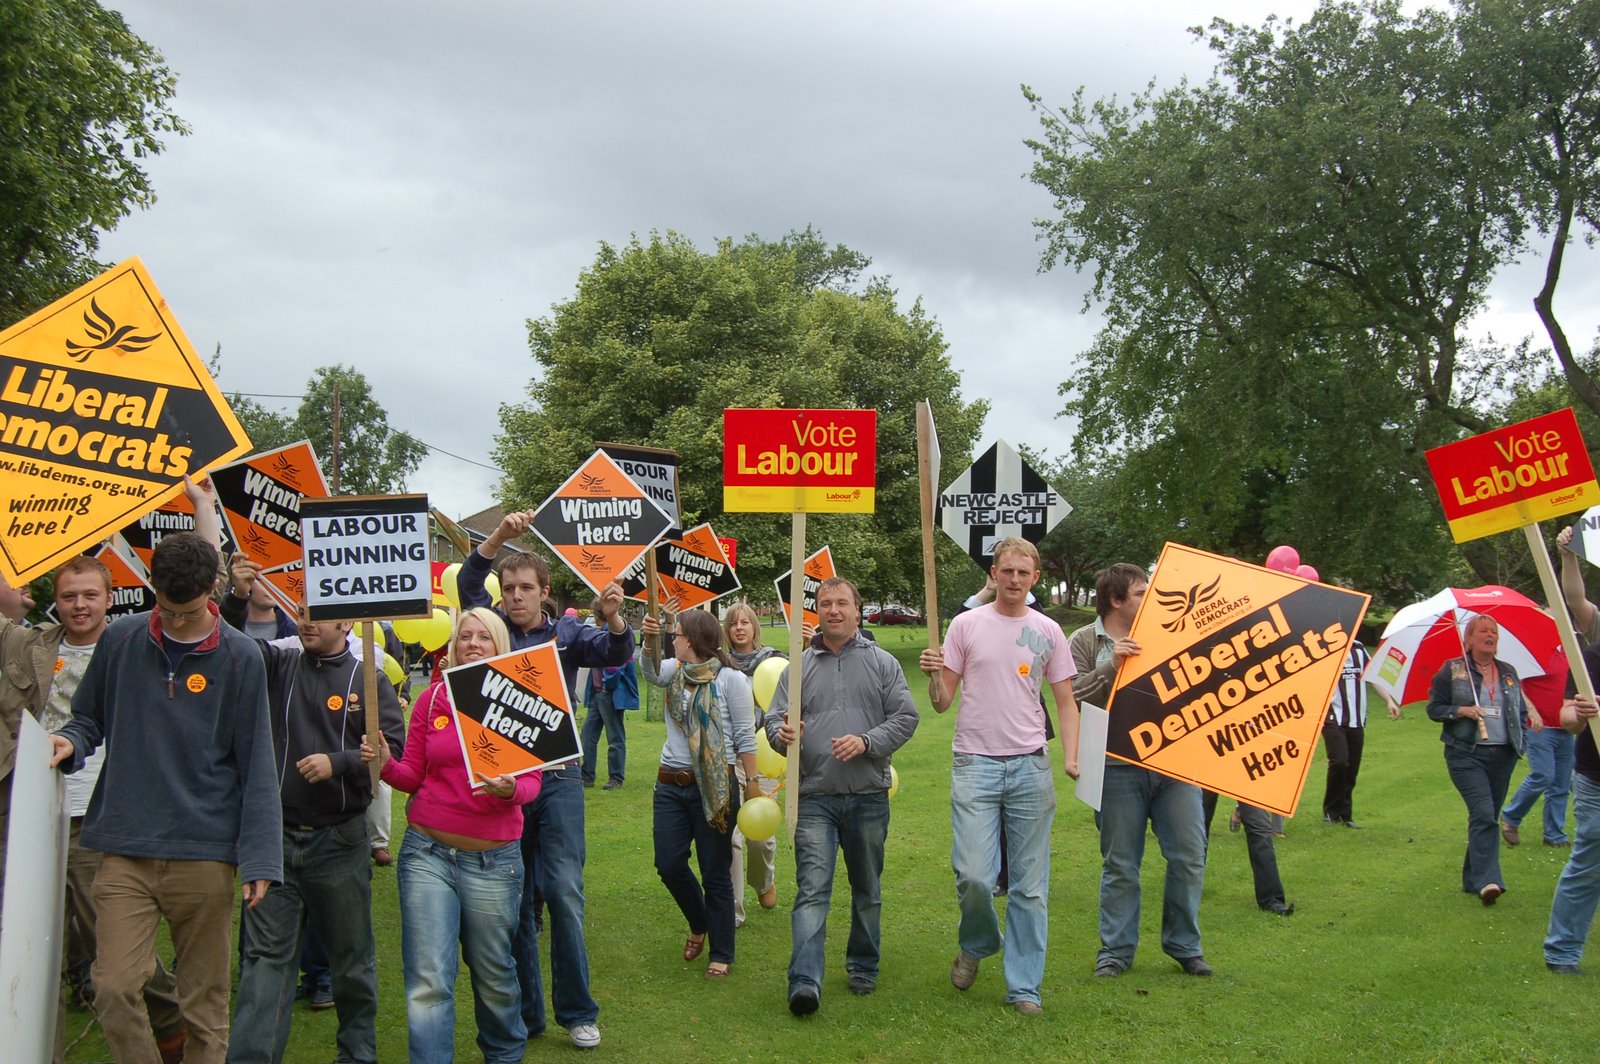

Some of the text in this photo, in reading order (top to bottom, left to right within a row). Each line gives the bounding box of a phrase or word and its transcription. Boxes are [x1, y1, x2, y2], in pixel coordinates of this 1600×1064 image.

[1, 364, 169, 429] Liberal
[0, 411, 193, 478] mocrats
[792, 420, 857, 447] Vote
[1494, 430, 1562, 463] Vote
[614, 460, 668, 481] BOUR
[738, 444, 858, 475] Labour
[0, 460, 148, 499] w.libdems.org.uk
[244, 468, 304, 514] Winni
[1451, 452, 1569, 506] Labour
[9, 492, 93, 516] winning
[560, 496, 643, 523] Winning
[941, 493, 1057, 508] NEWCASTLE
[313, 514, 417, 538] LABOUR
[963, 509, 1042, 525] REJECT
[577, 521, 631, 546] Here!
[308, 542, 425, 568] RUNNING
[669, 545, 725, 577] Winning
[319, 574, 417, 598] SCARED
[674, 564, 712, 588] Here!
[112, 586, 144, 607] ning
[1191, 597, 1229, 621] LIBERAL
[1195, 595, 1250, 629] DEMOCRATS
[1150, 603, 1292, 705] Liberal
[480, 669, 565, 732] Winning
[1128, 622, 1349, 761] Democrats
[481, 702, 541, 749] Here!
[1206, 693, 1305, 758] Winning
[1241, 739, 1300, 782] Here
